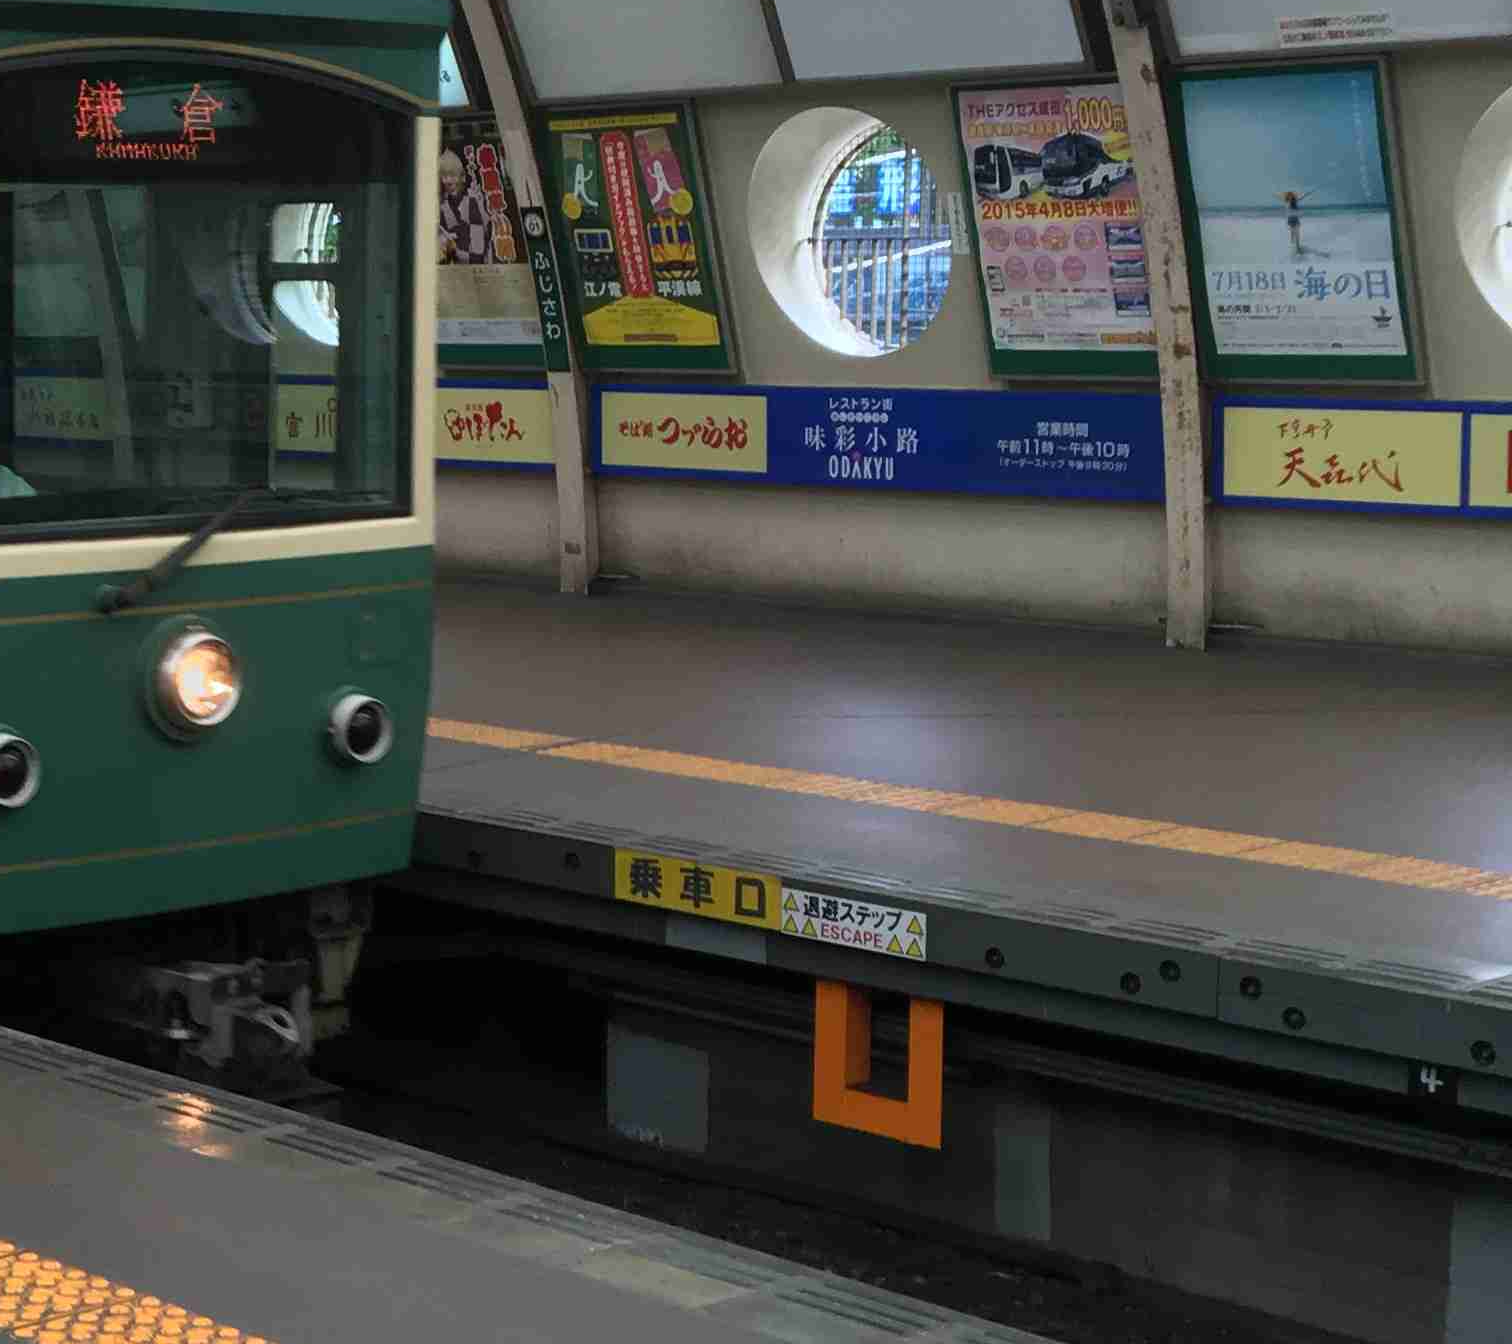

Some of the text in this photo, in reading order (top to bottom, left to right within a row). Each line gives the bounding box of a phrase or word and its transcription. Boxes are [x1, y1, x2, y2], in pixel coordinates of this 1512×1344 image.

[534, 251, 561, 339] ふじさわ
[1293, 266, 1392, 301] 海の日
[804, 425, 920, 454] 味彩小路
[829, 454, 894, 481] ODAKYU
[630, 858, 767, 919] 乗車口
[804, 893, 903, 932] 退避ステップ
[820, 922, 883, 949] ESCAPE
